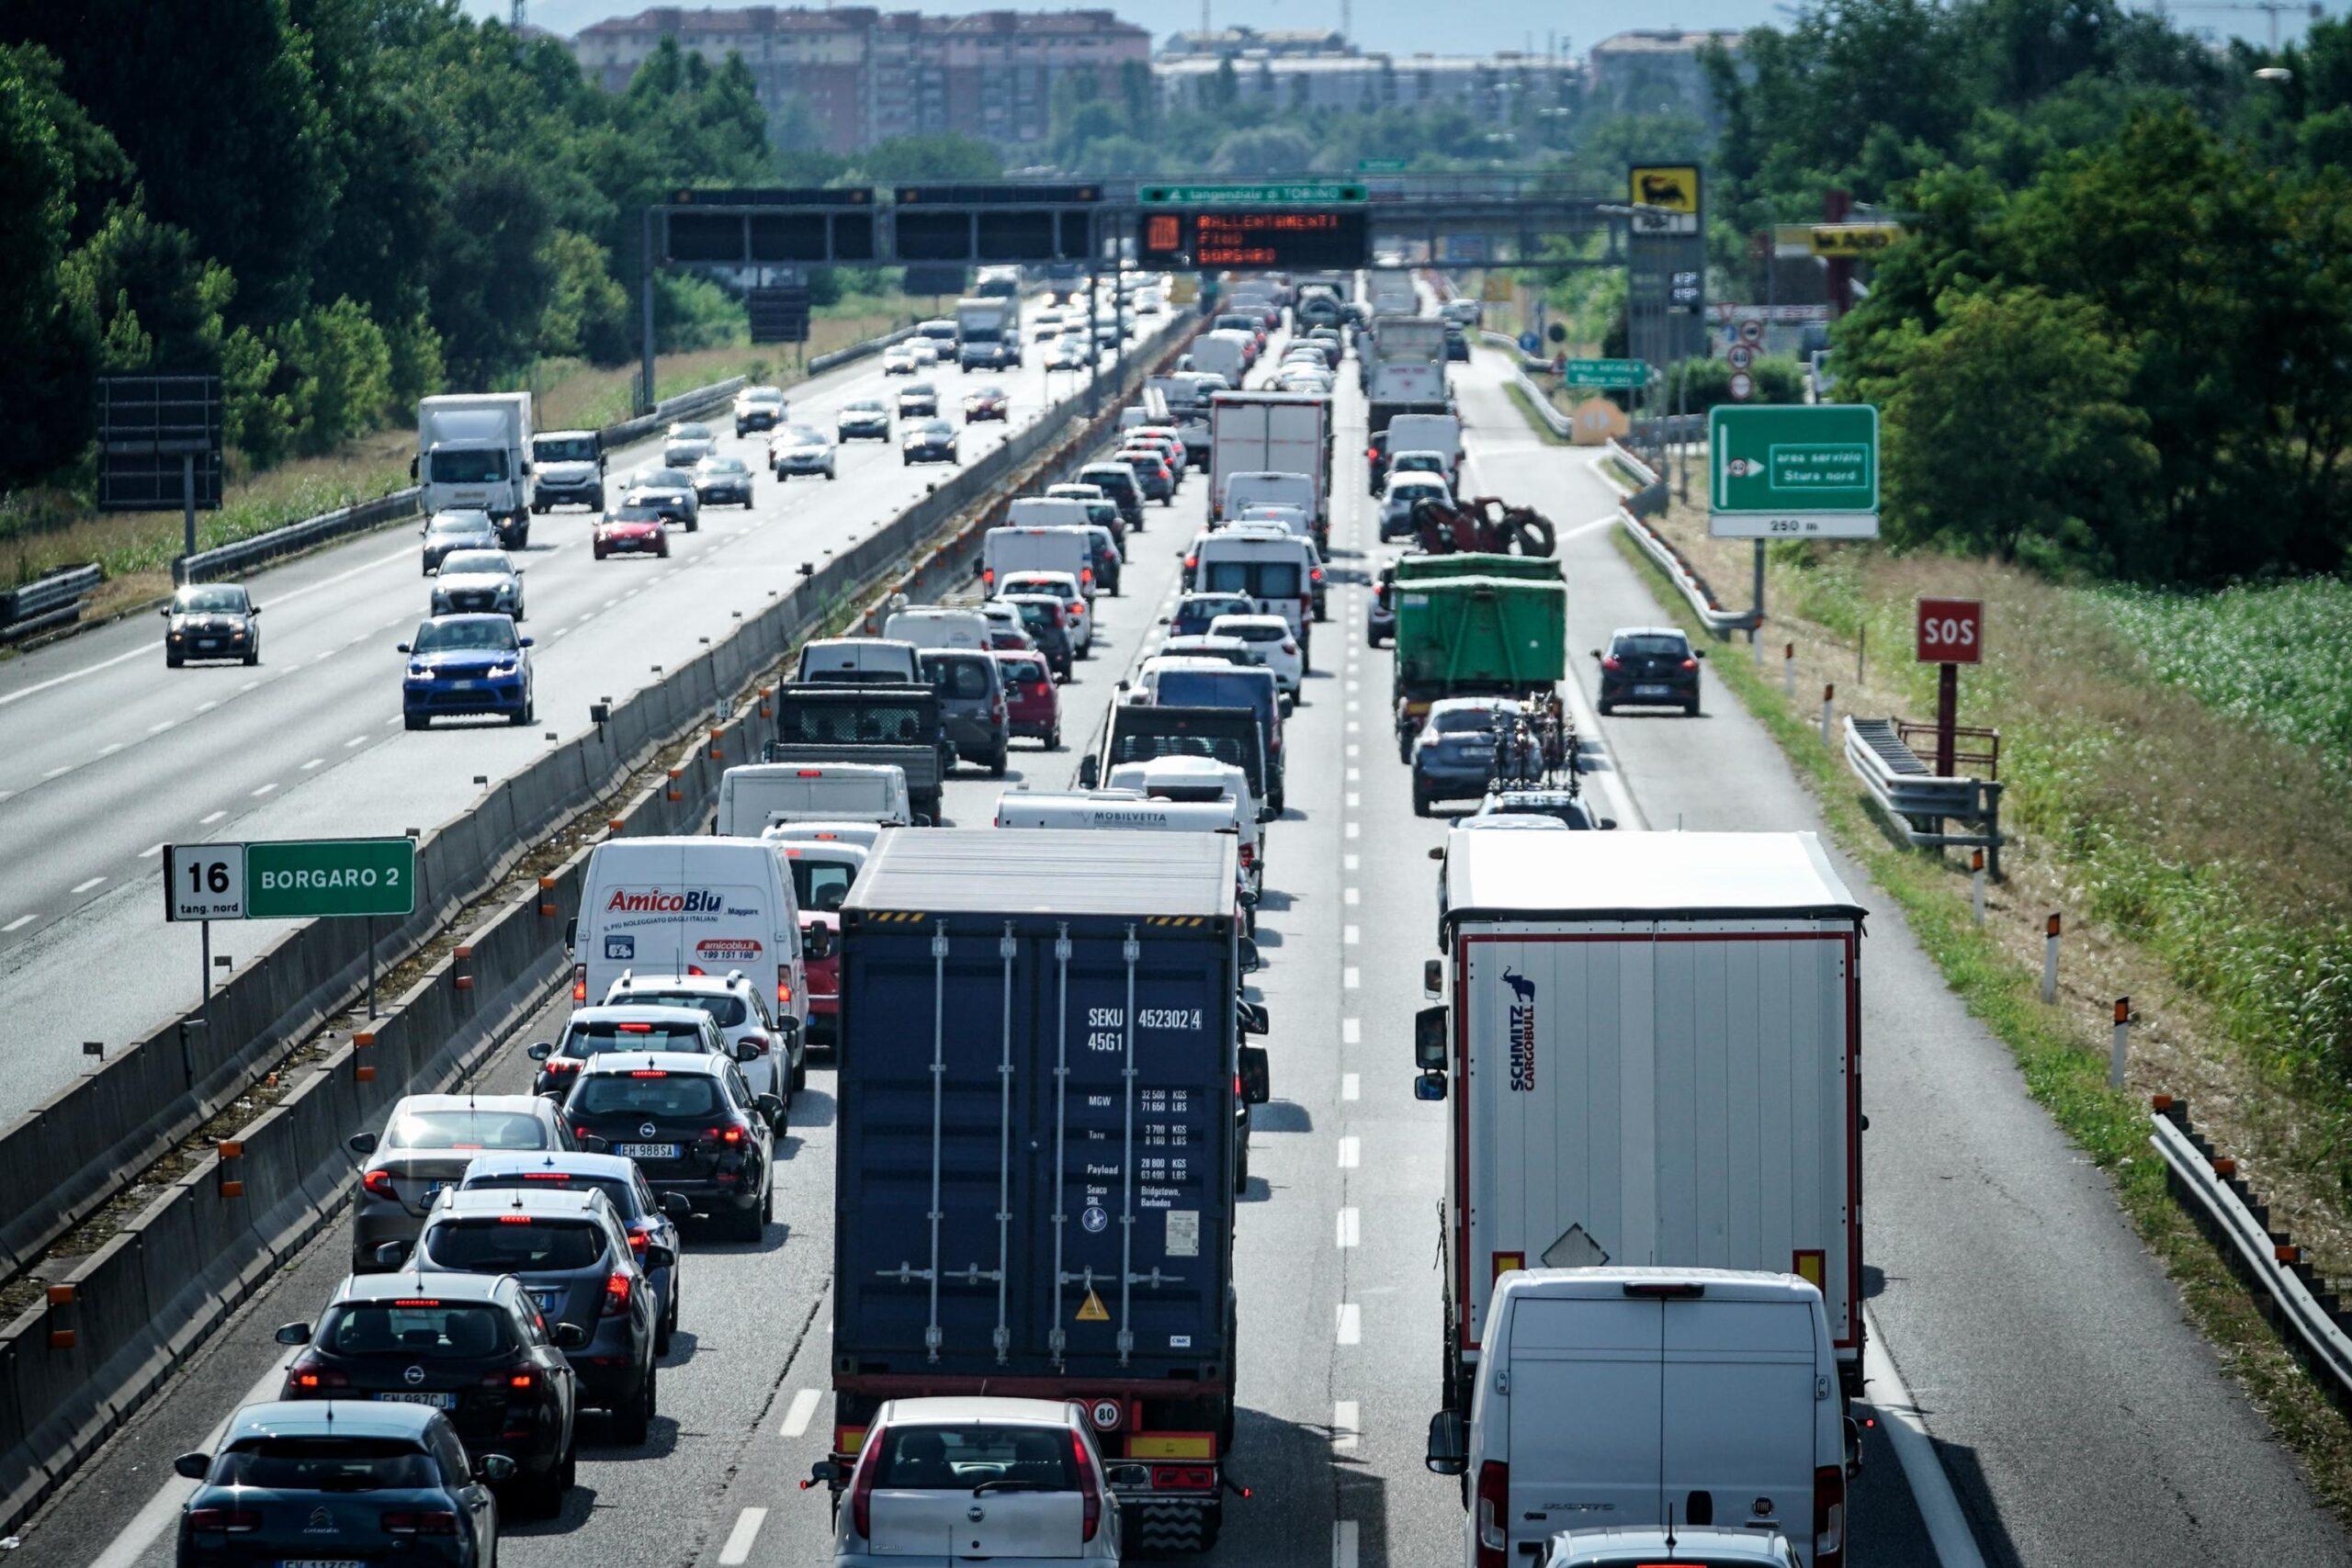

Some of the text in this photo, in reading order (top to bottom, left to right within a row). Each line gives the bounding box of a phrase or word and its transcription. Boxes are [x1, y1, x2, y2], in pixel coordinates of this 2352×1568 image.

[1770, 520, 1817, 532] 250 m
[1924, 617, 1974, 644] SOS
[1094, 812, 1167, 821] MOBILVETTA
[188, 862, 230, 893] 16
[261, 867, 399, 889] BORGARO 2
[607, 889, 722, 912] AmicoBlu
[180, 903, 239, 914] tang. nord
[624, 918, 667, 928] NOLEGGIATO
[704, 941, 755, 951] amicoblu.it
[703, 951, 754, 959] 199 151 198
[1089, 1009, 1123, 1027] SEKU
[1138, 1010, 1188, 1028] 452302
[1088, 1032, 1123, 1051] 45G1
[1510, 1005, 1524, 1091] SCHMITZ
[1524, 1005, 1534, 1091] CARGOBULL
[1141, 1090, 1150, 1100] 32
[1172, 1090, 1187, 1100] KGS
[1089, 1096, 1111, 1106] MGW
[1142, 1102, 1149, 1111] 71
[1172, 1102, 1187, 1111] LBS
[1152, 1125, 1165, 1134] 700
[1172, 1125, 1187, 1134] KGS
[1089, 1131, 1105, 1139] Tare
[1172, 1136, 1187, 1145] LBS
[622, 1145, 673, 1156] EH 988SA
[1141, 1158, 1186, 1168] 28 800 KGS
[1087, 1164, 1118, 1175] Payload
[1172, 1171, 1186, 1179] LBS
[1087, 1184, 1108, 1194] Seaco
[1141, 1186, 1181, 1197] Bridgetown,
[1141, 1198, 1171, 1207] Barbados
[1099, 1408, 1114, 1420] 80
